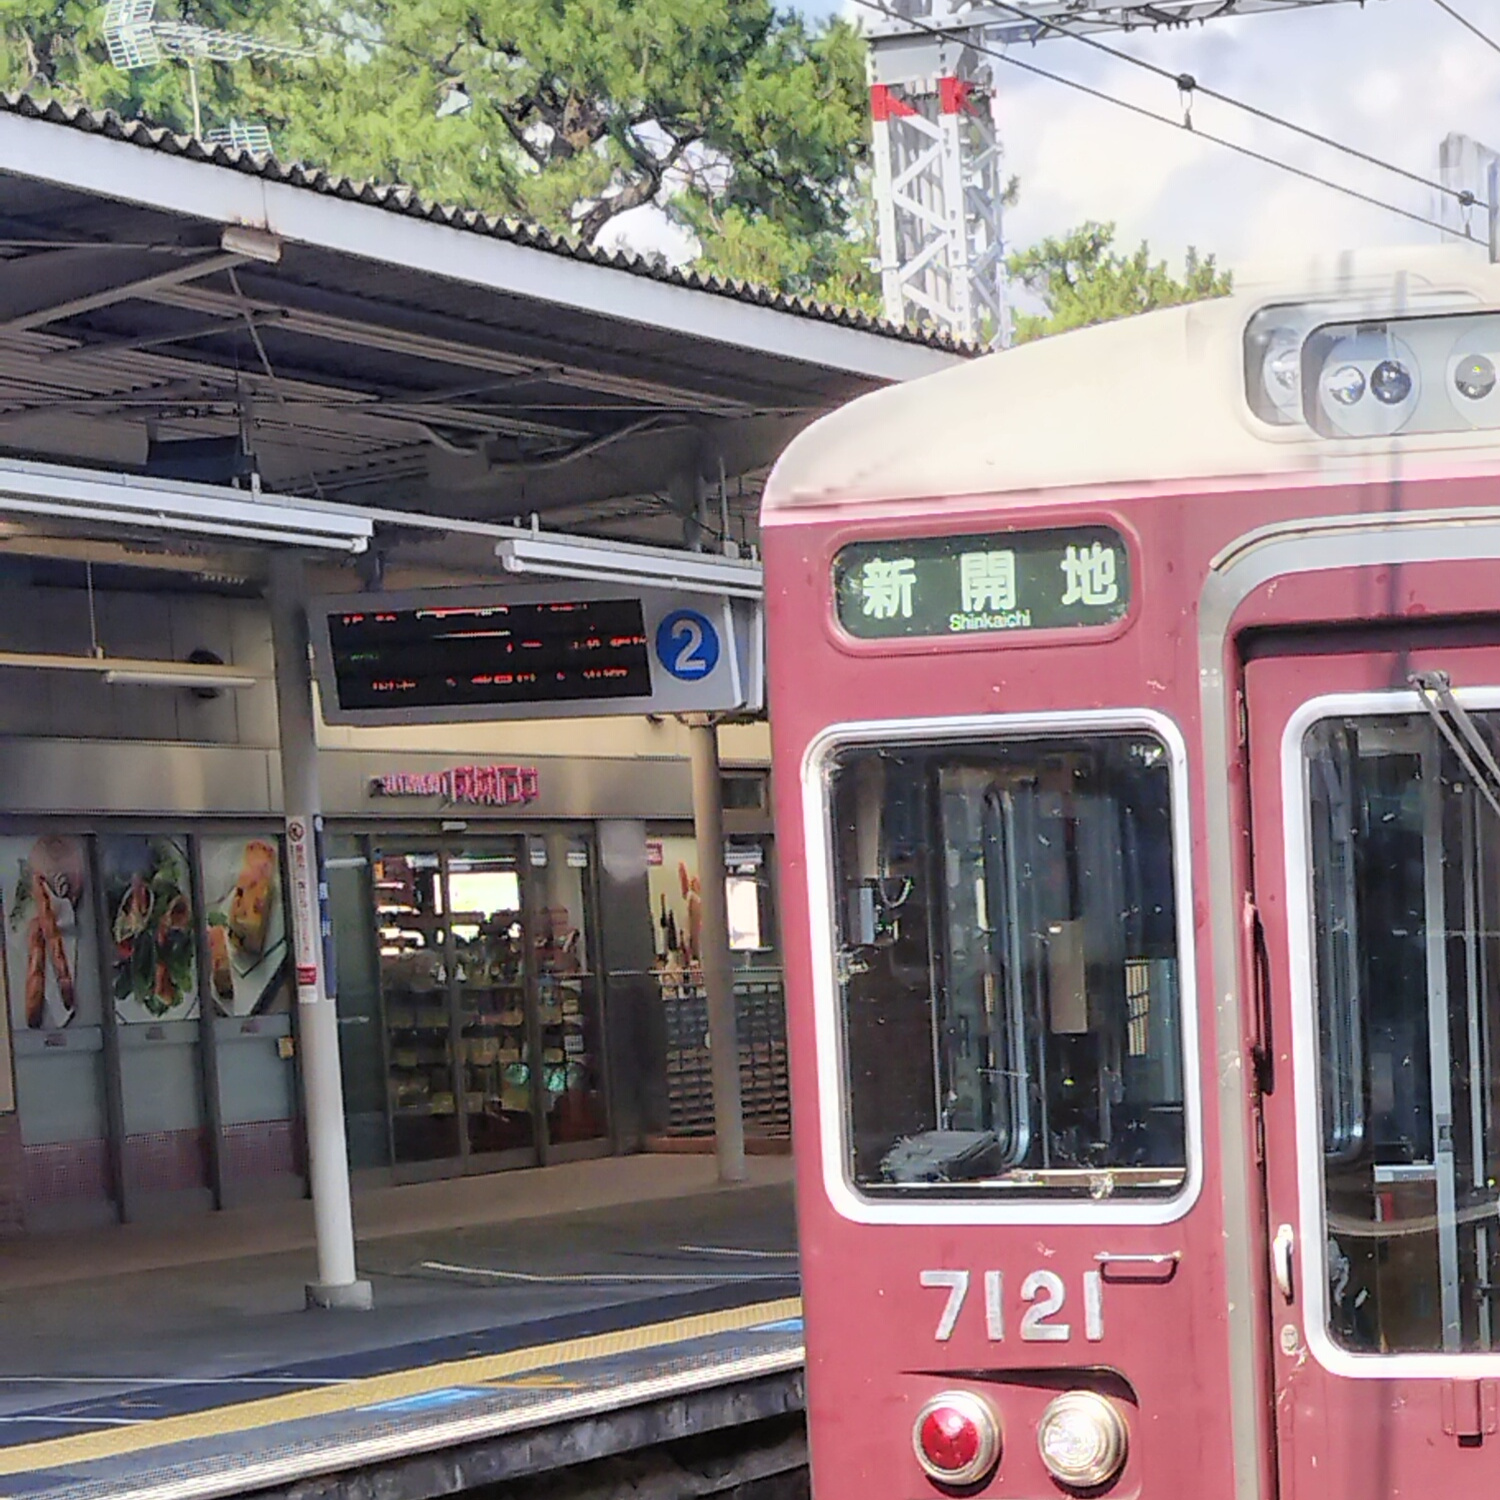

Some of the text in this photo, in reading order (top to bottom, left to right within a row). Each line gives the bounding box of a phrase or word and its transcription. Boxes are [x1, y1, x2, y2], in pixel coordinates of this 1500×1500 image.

[862, 541, 1119, 620] 新開地
[670, 617, 707, 672] 2
[948, 608, 1031, 632] Shinkaichi
[918, 1268, 1105, 1342] 7121
